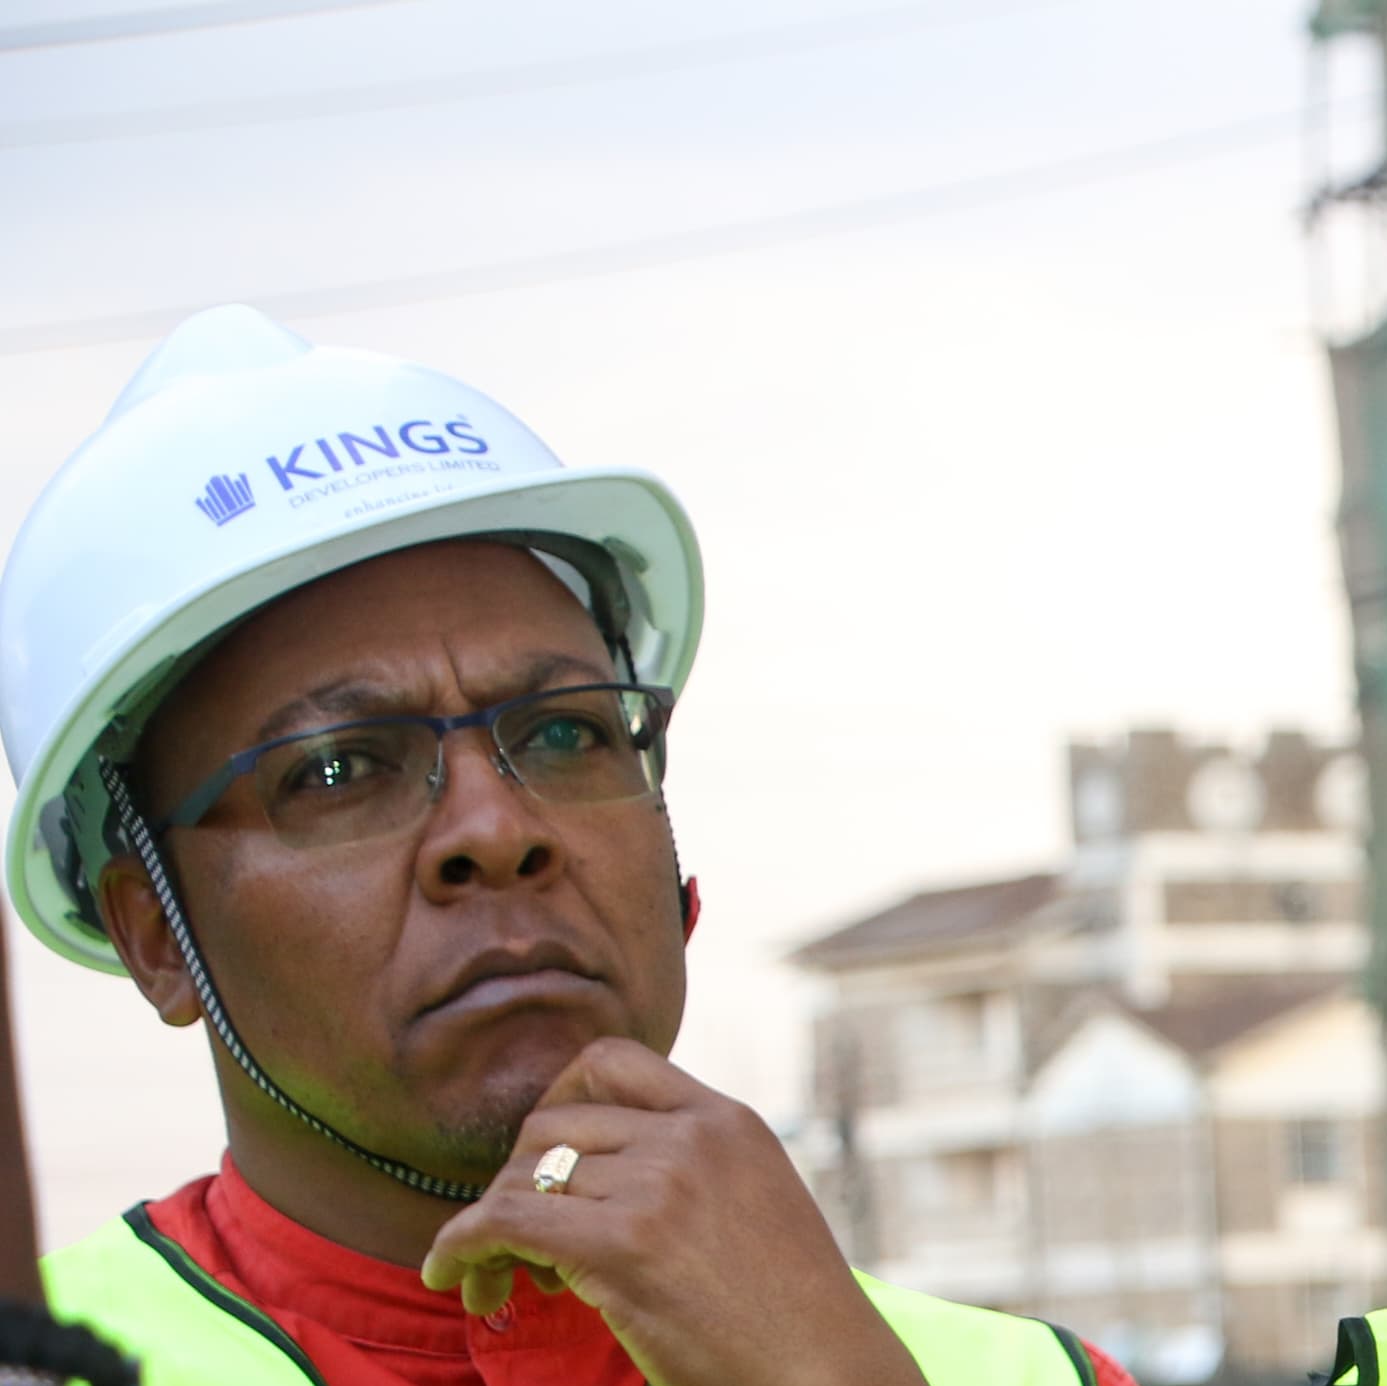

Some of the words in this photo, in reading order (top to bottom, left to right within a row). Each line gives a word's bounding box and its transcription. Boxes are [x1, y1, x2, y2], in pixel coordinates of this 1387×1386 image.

[266, 419, 489, 491] KINGS
[288, 460, 425, 509] DEVELOPERS
[427, 458, 500, 473] LIMITED
